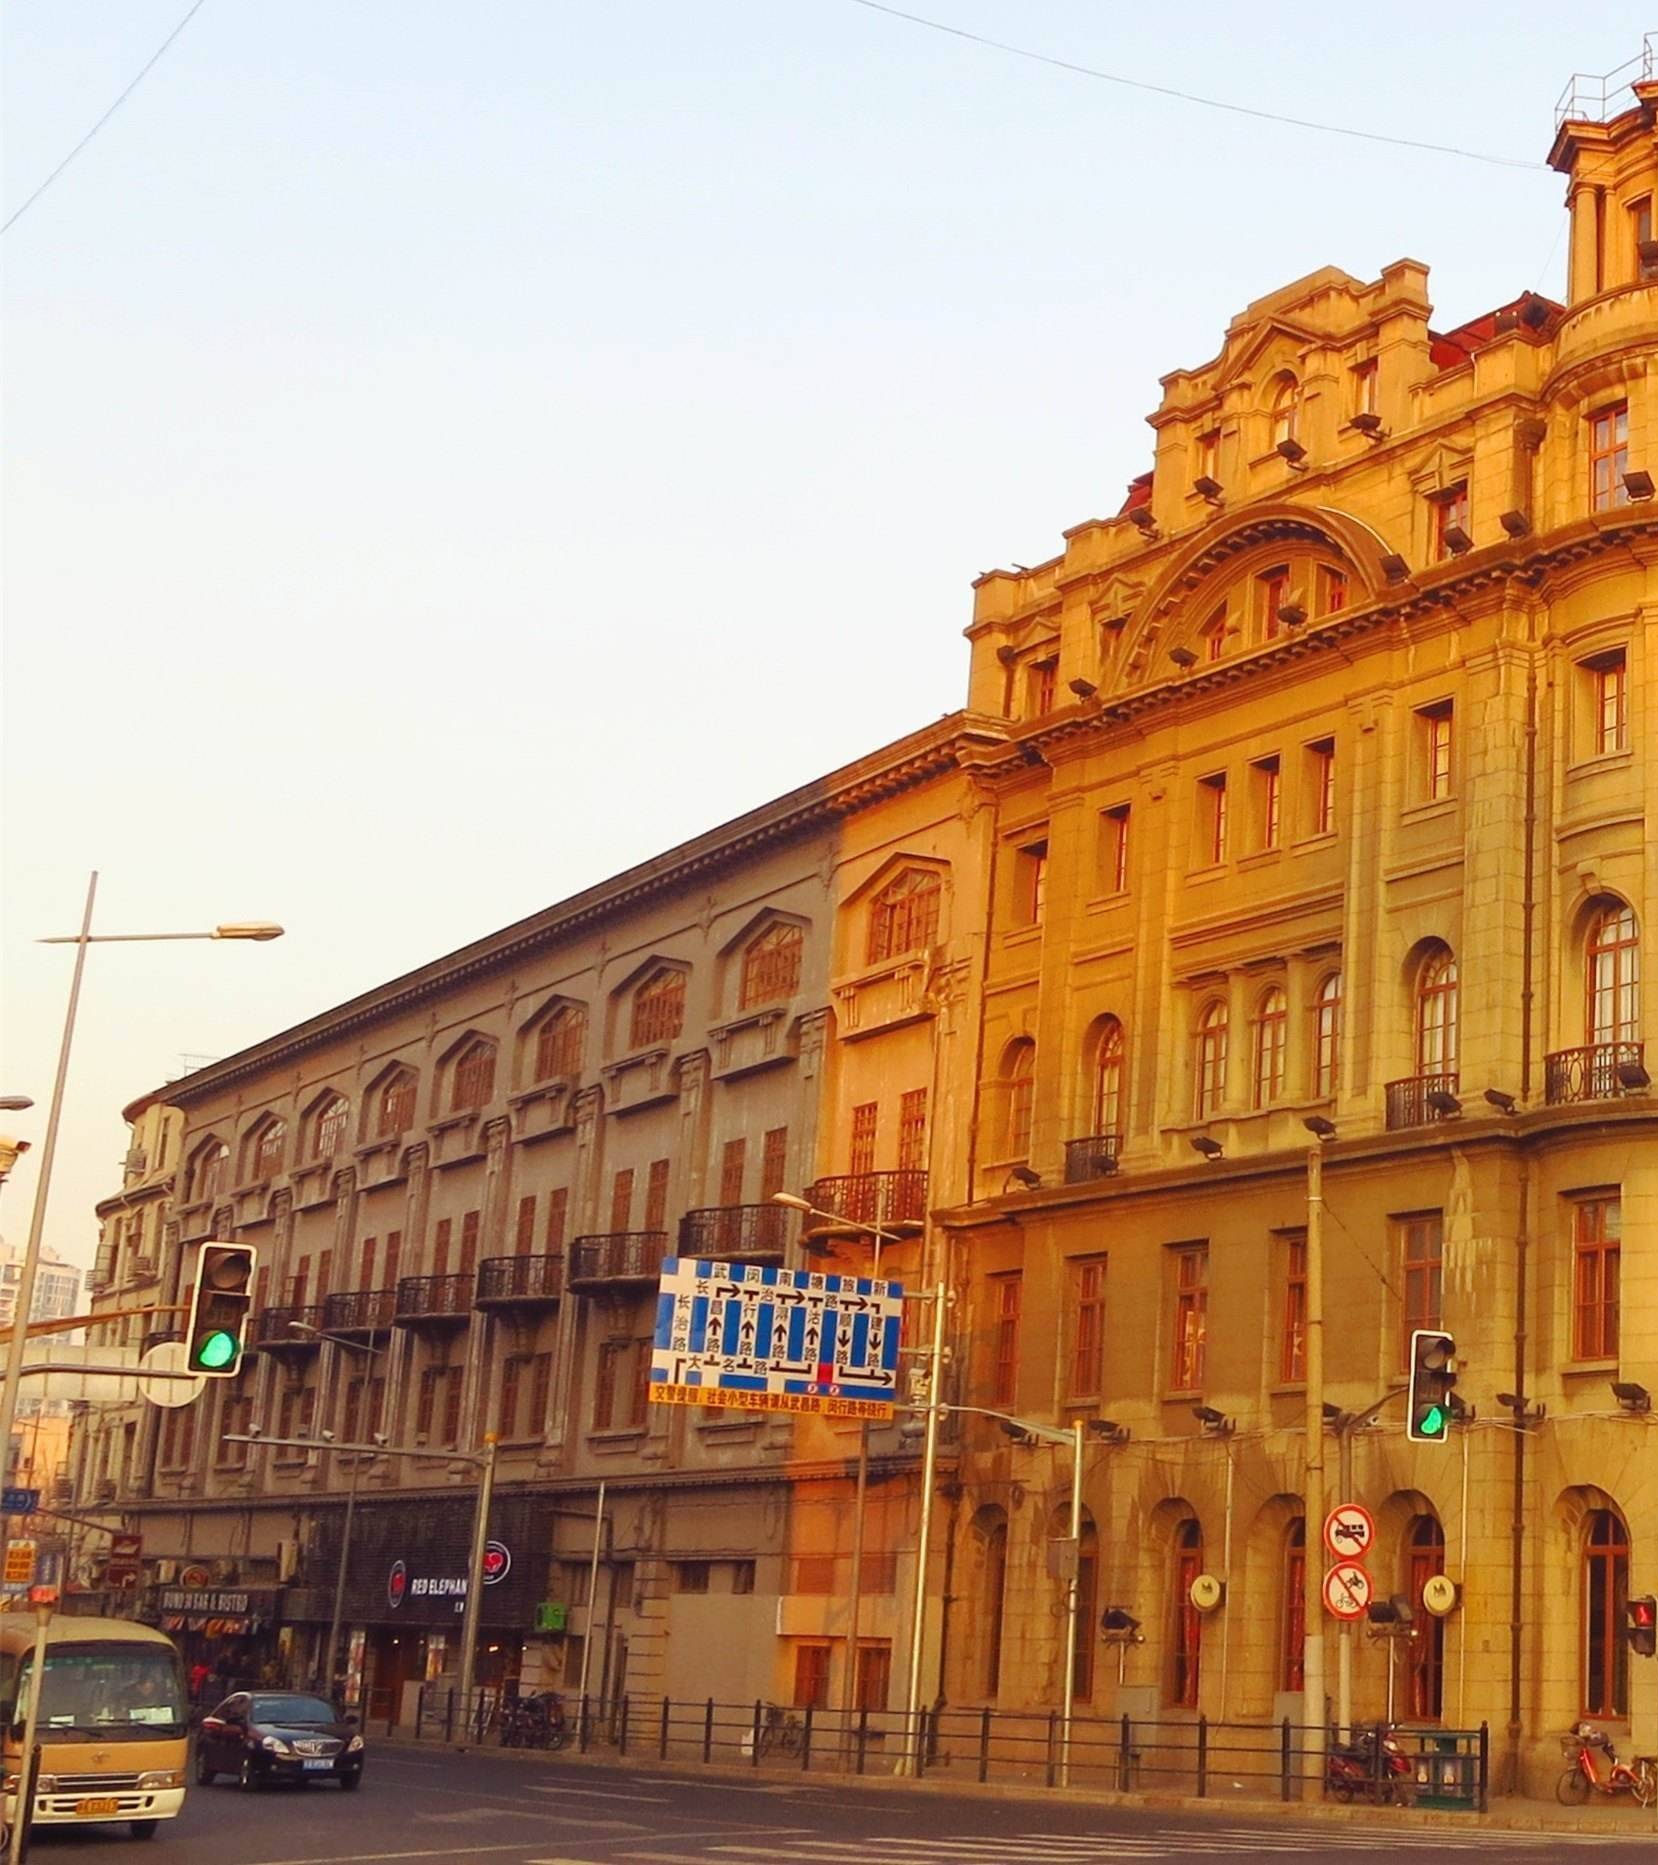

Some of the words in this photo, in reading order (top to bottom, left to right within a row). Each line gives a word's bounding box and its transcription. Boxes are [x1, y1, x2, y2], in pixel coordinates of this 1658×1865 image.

[672, 1294, 691, 1352] 长治路
[688, 1356, 769, 1376] 大名路
[411, 1579, 428, 1595] RED
[428, 1578, 468, 1595] ELEPHAN
